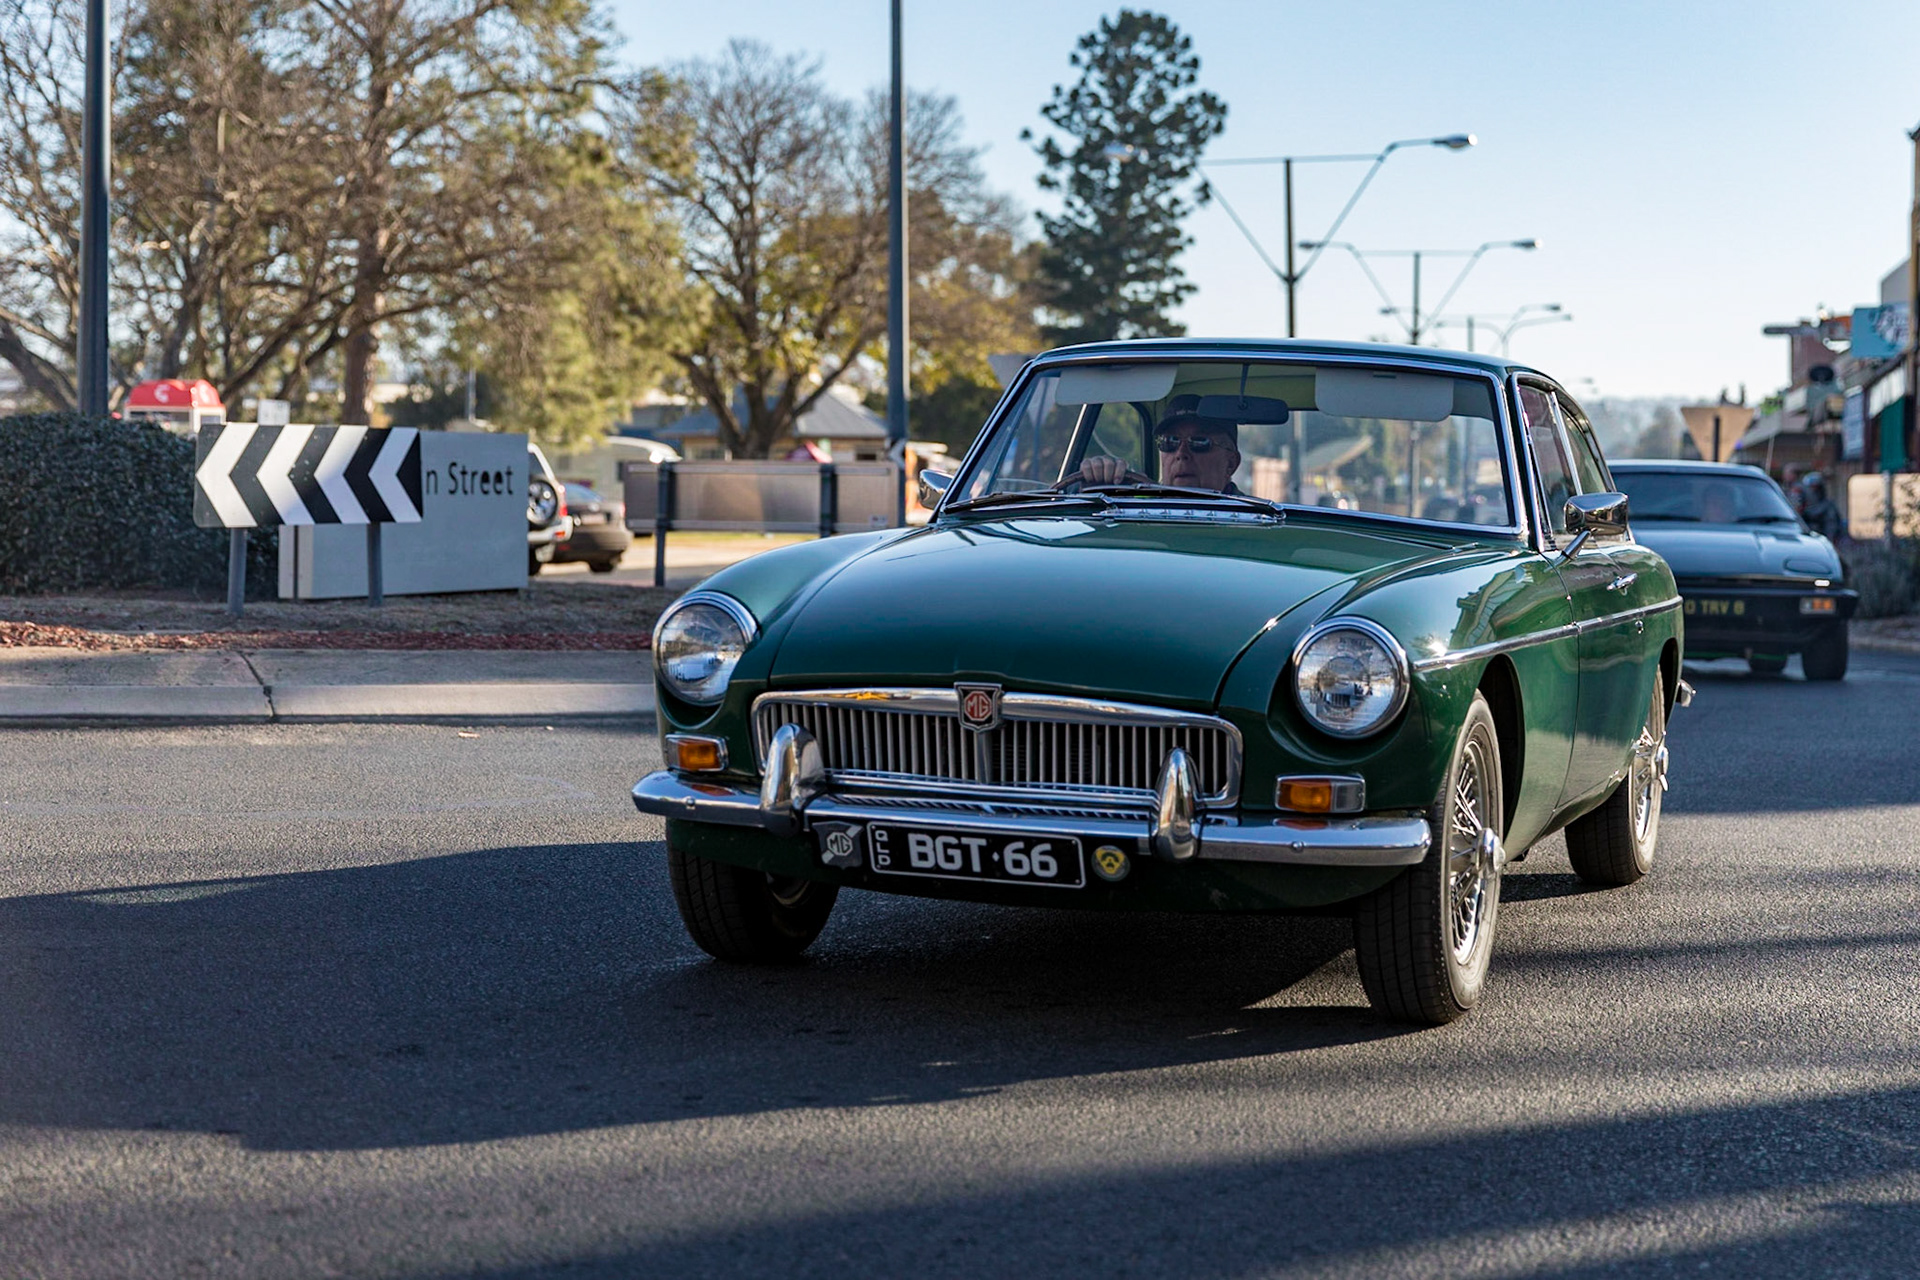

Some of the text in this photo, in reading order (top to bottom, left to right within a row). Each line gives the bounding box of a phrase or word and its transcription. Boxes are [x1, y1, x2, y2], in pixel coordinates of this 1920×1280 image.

[448, 462, 513, 495] Street
[967, 695, 989, 717] MG
[829, 834, 851, 854] MG
[875, 830, 891, 865] QLD
